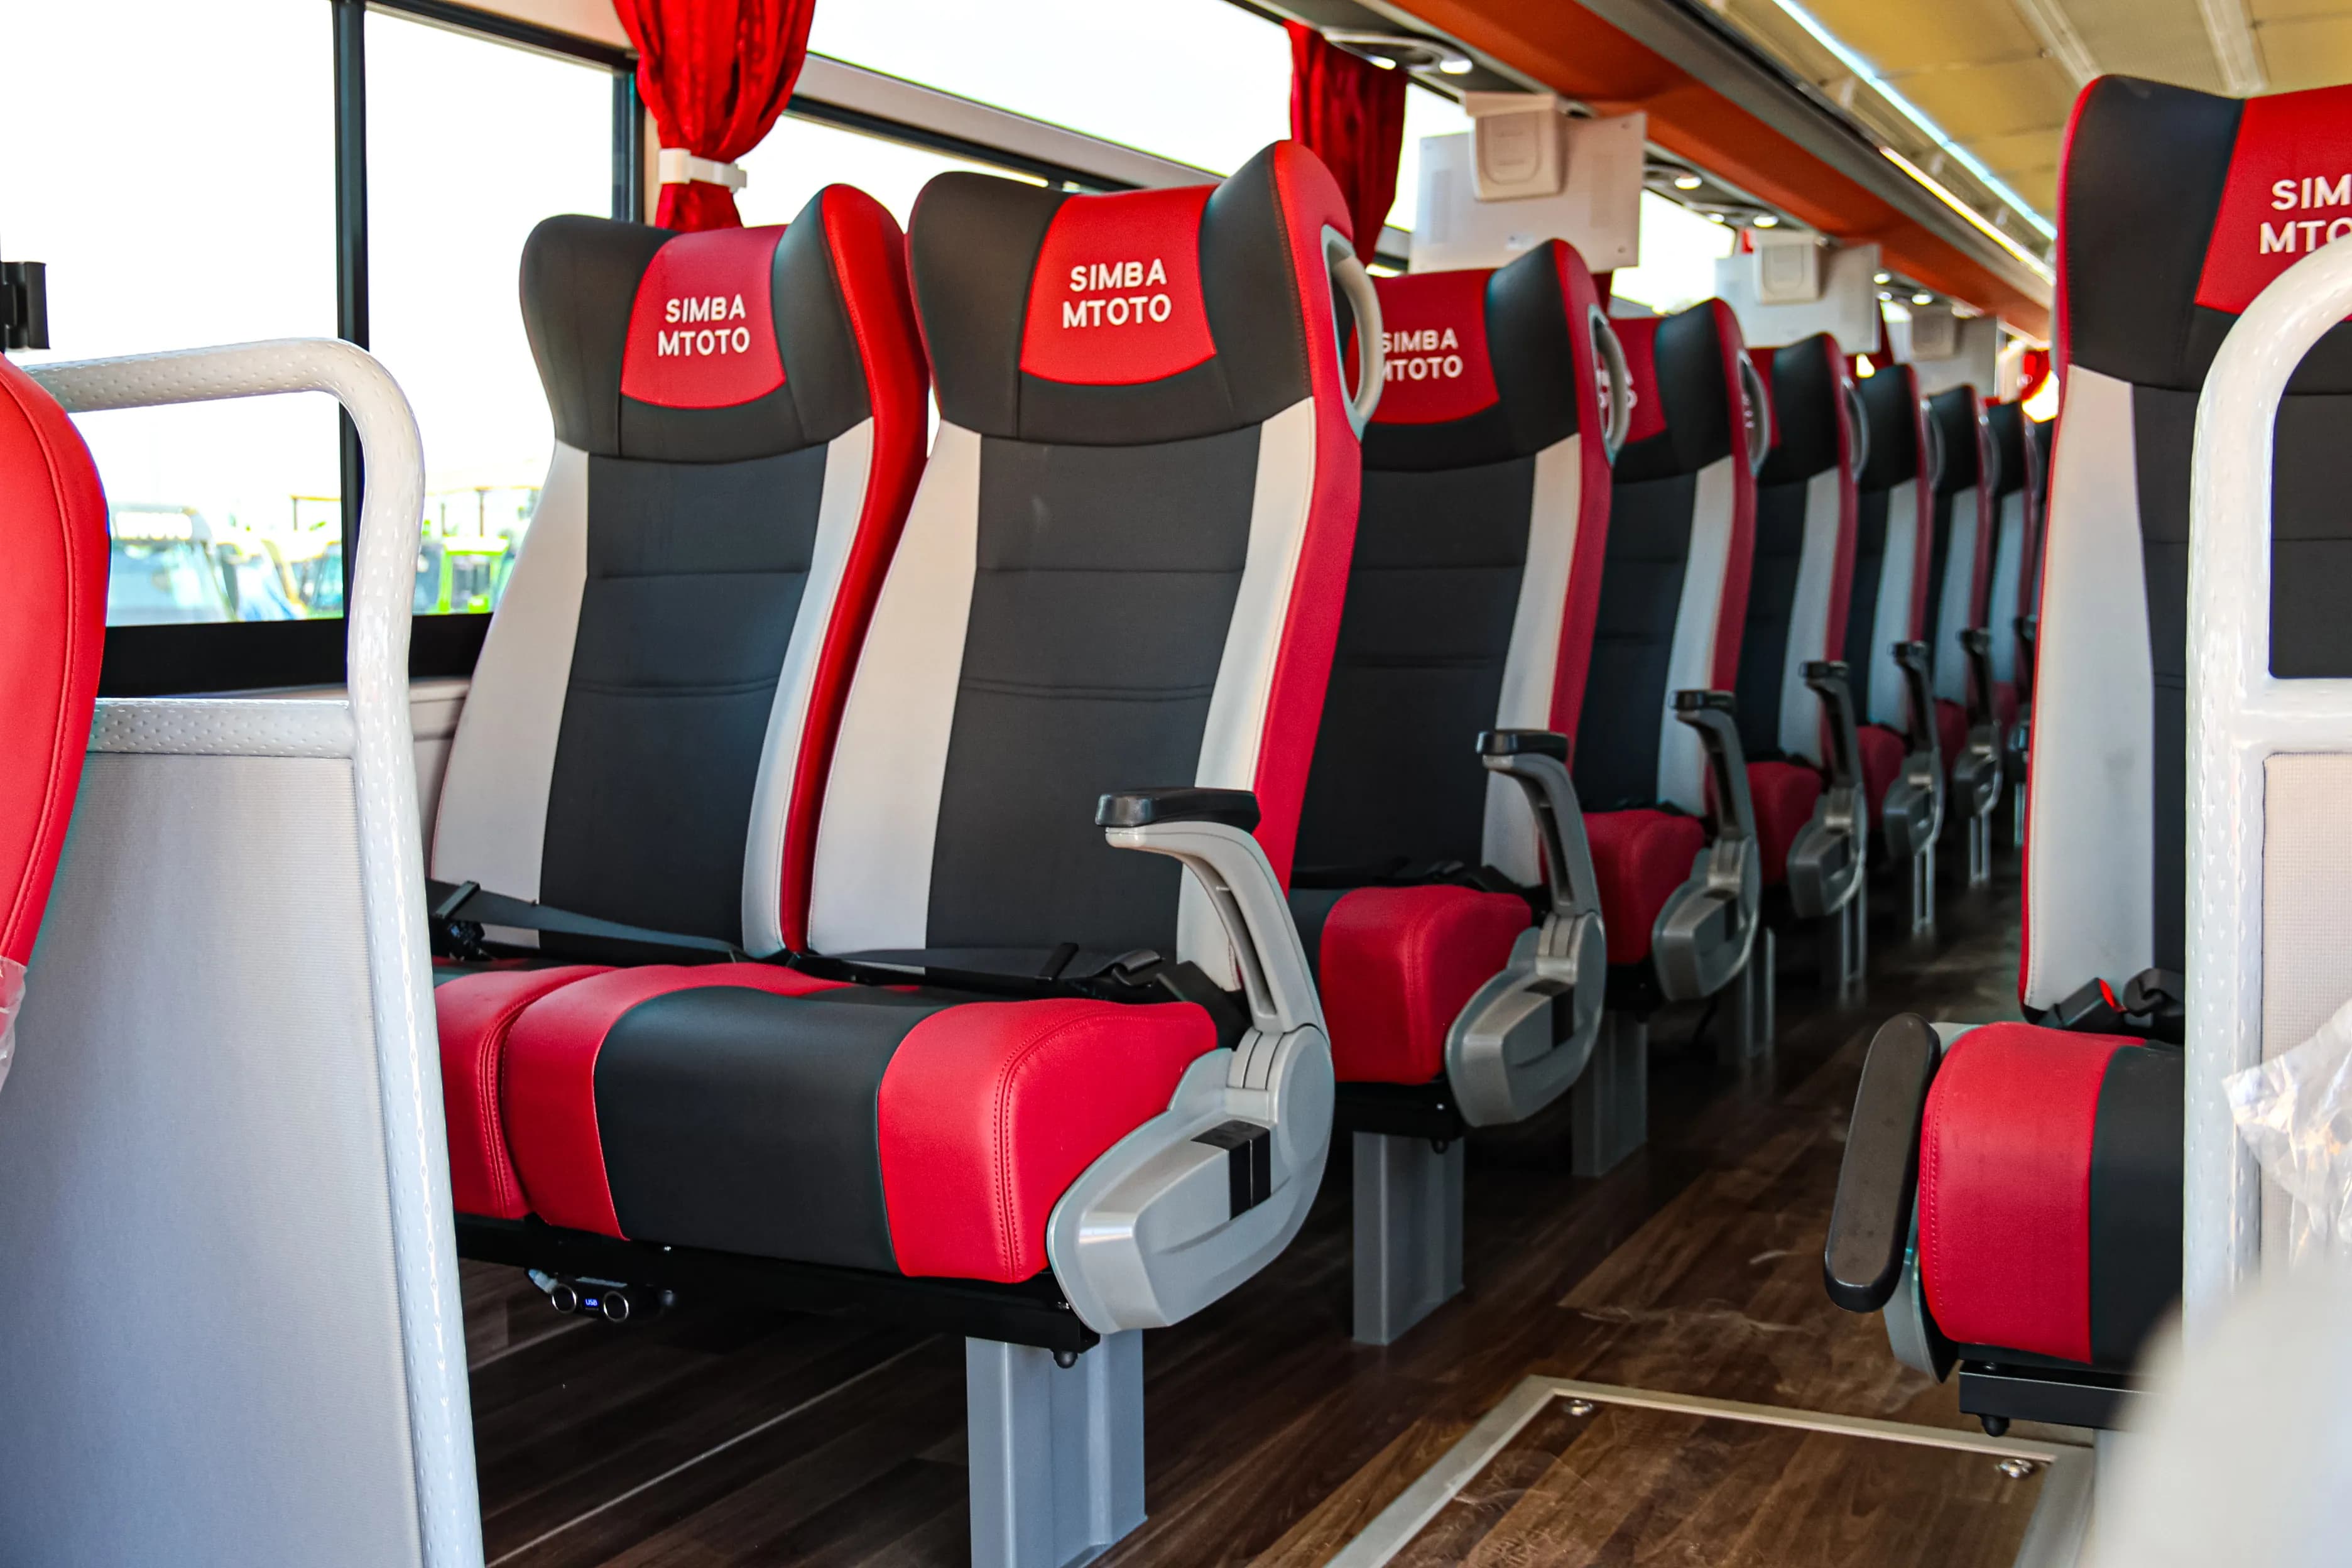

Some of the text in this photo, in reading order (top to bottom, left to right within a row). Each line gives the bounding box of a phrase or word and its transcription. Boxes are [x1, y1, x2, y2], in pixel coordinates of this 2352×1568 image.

[2271, 173, 2351, 210] SIM
[1069, 258, 1167, 291] SIMBA
[665, 294, 746, 323] SIMBA
[1062, 293, 1172, 329] MTOTO
[658, 326, 750, 356] MTOTO
